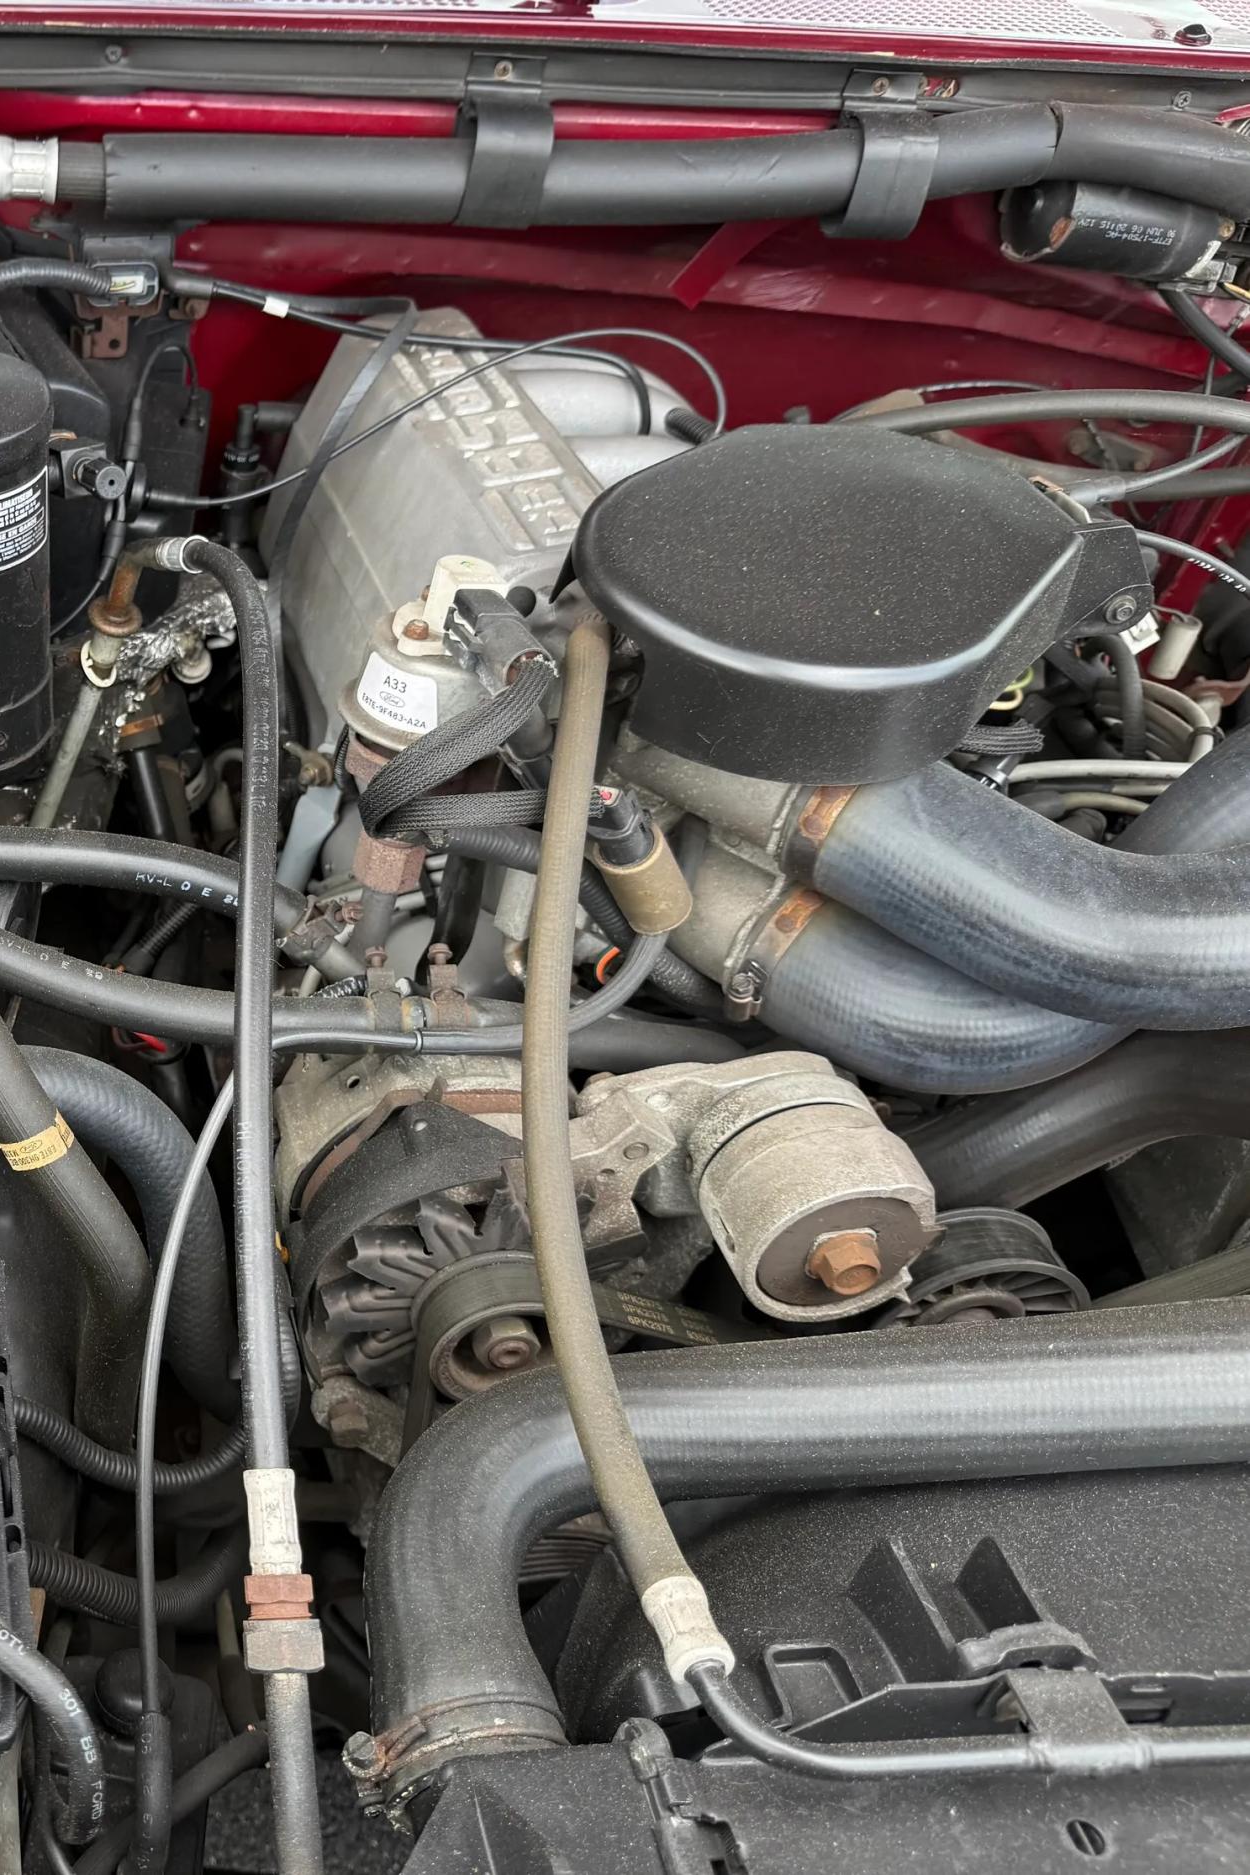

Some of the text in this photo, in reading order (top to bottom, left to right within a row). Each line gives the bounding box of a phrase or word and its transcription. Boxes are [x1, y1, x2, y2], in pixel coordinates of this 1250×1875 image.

[7, 527, 19, 538] EN
[383, 675, 407, 694] A33
[58, 1687, 83, 1718] 301
[90, 1780, 104, 1821] FORD
